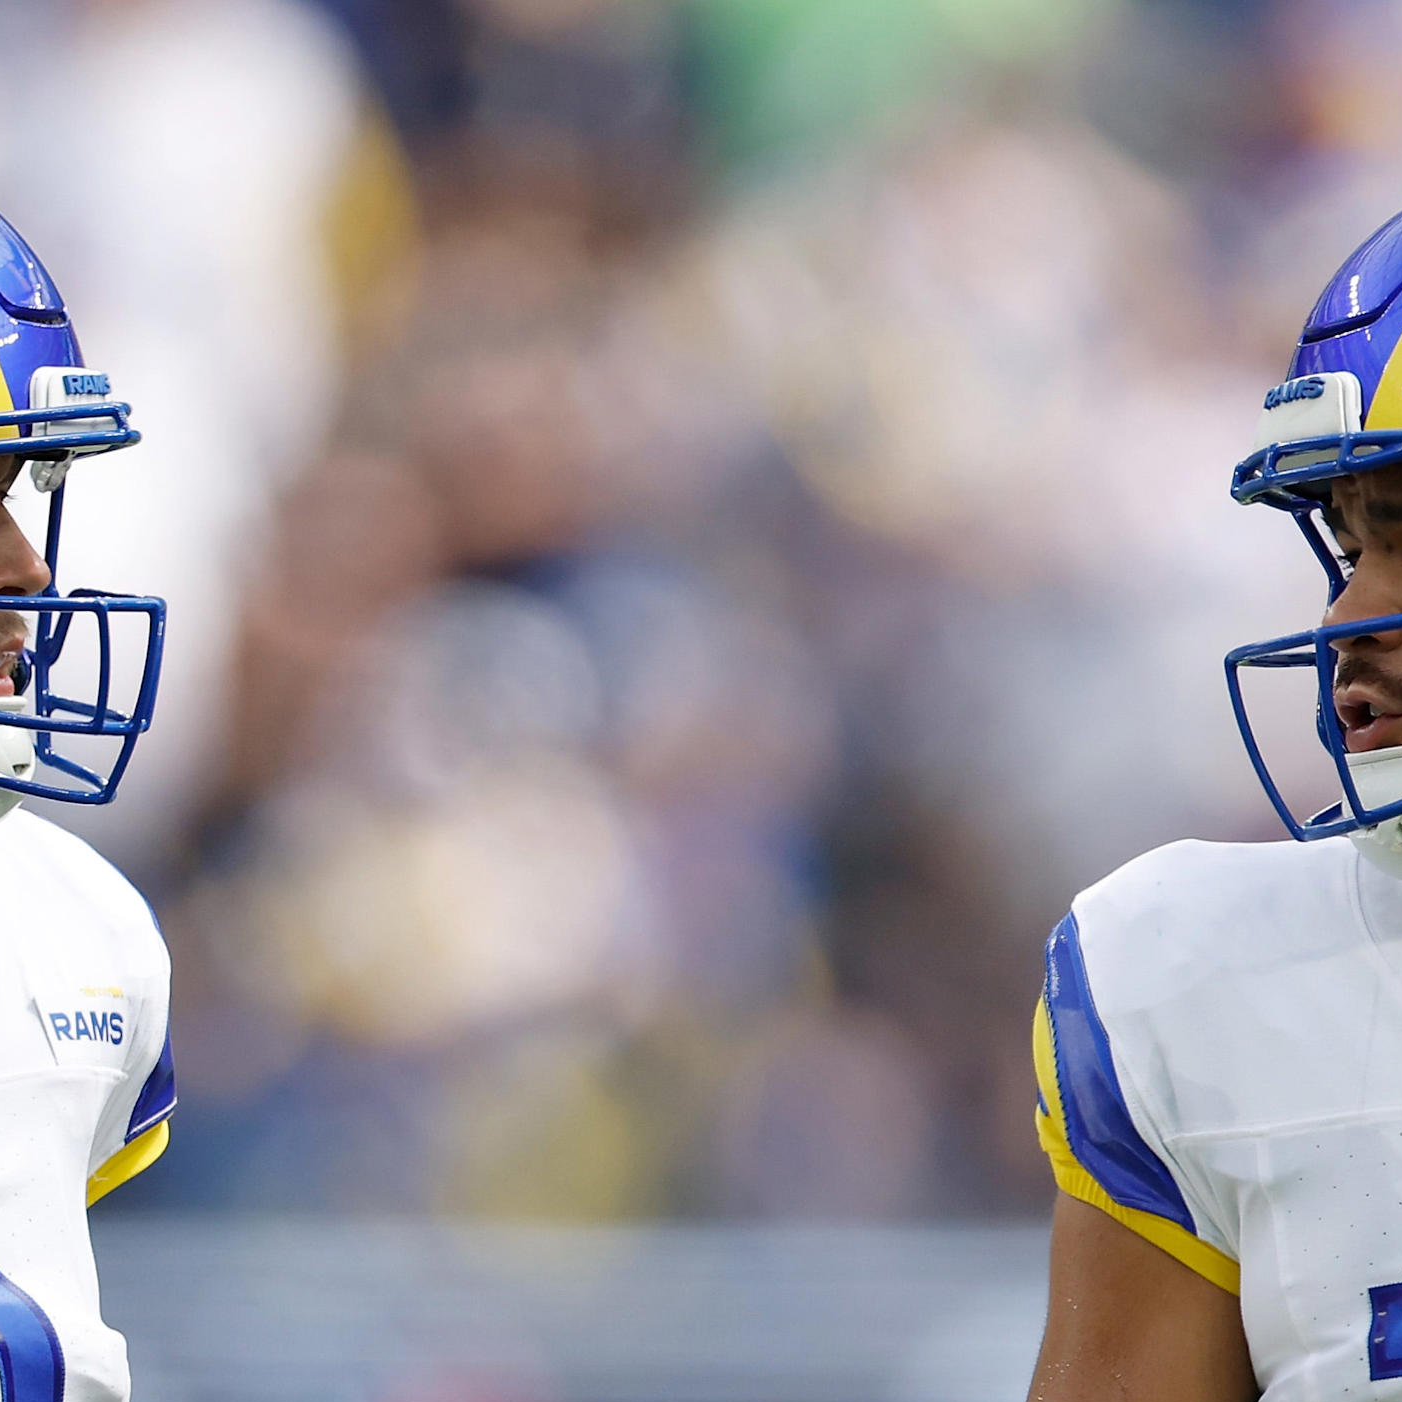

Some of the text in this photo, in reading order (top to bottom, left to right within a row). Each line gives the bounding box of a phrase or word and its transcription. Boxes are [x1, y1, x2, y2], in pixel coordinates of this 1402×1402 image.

[63, 374, 111, 396] RAMS
[1264, 376, 1326, 410] RAMS
[49, 1011, 124, 1045] RAMS
